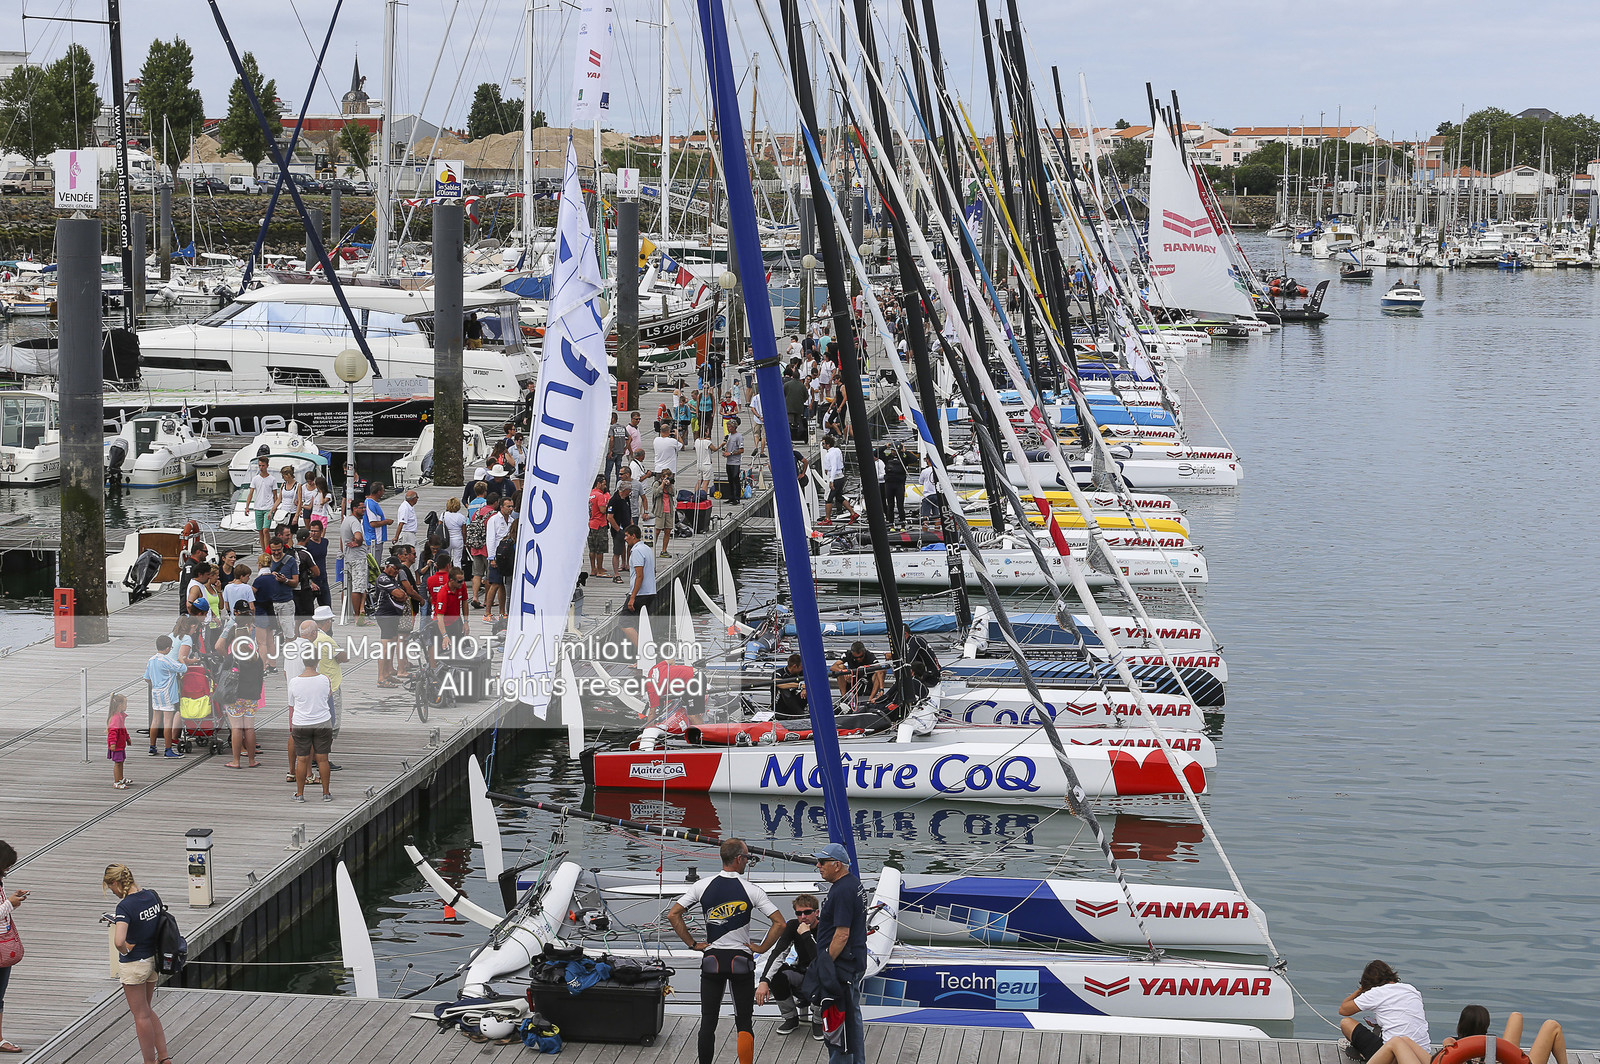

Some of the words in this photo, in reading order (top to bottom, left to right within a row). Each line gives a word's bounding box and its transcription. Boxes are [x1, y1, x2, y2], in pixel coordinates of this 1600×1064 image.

[114, 105, 129, 248] www.teamplastique.com
[58, 191, 94, 203] VENDÉE
[646, 326, 661, 338] LS
[662, 314, 700, 334] 266506
[1133, 430, 1176, 438] YANMAR
[1185, 451, 1233, 460] YANMAR
[1117, 499, 1171, 509] YANMAR
[1123, 537, 1184, 548] YANMAR
[963, 700, 1057, 725] CoQ
[1103, 703, 1191, 717] YANMAR
[631, 766, 662, 775] Maître
[663, 766, 684, 775] CoQ
[929, 753, 1041, 793] CoQ
[139, 903, 161, 921] CREW
[1129, 901, 1250, 919] YANMAR
[935, 970, 1040, 996] Techneau
[1138, 977, 1272, 996] YANMAR
